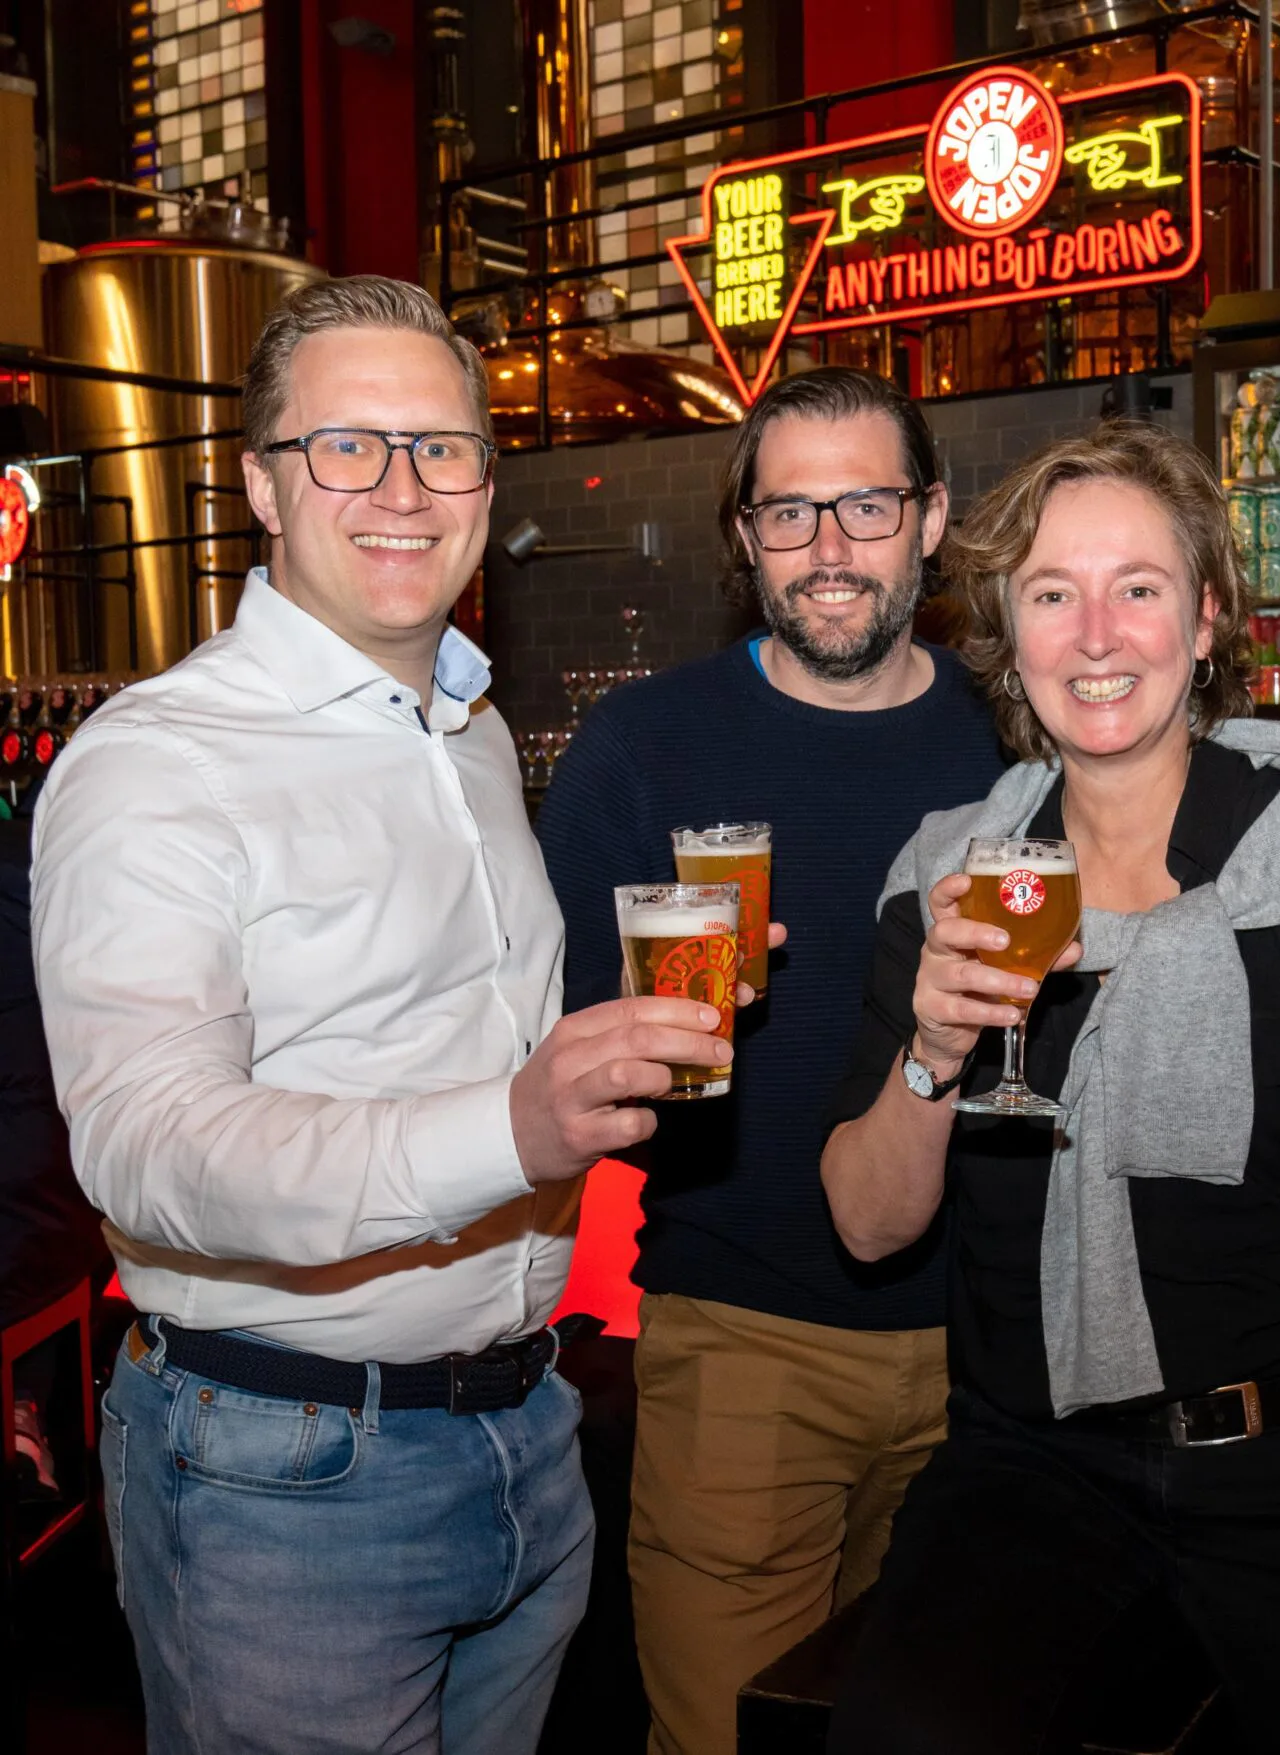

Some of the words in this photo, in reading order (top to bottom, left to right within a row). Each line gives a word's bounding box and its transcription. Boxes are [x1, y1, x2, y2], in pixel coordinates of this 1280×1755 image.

[938, 81, 1038, 163] JOPEN
[714, 174, 783, 221] YOUR
[948, 144, 1050, 225] JOPEN
[716, 213, 784, 260] BEER
[716, 253, 785, 289] BREWED
[825, 241, 991, 313] ANYTHING
[993, 227, 1051, 290] BUT
[1050, 209, 1182, 280] BORING
[716, 281, 783, 328] HERE
[1001, 870, 1040, 892] JOPEN
[1005, 892, 1045, 914] JOPEN
[658, 937, 735, 993] JOPEN
